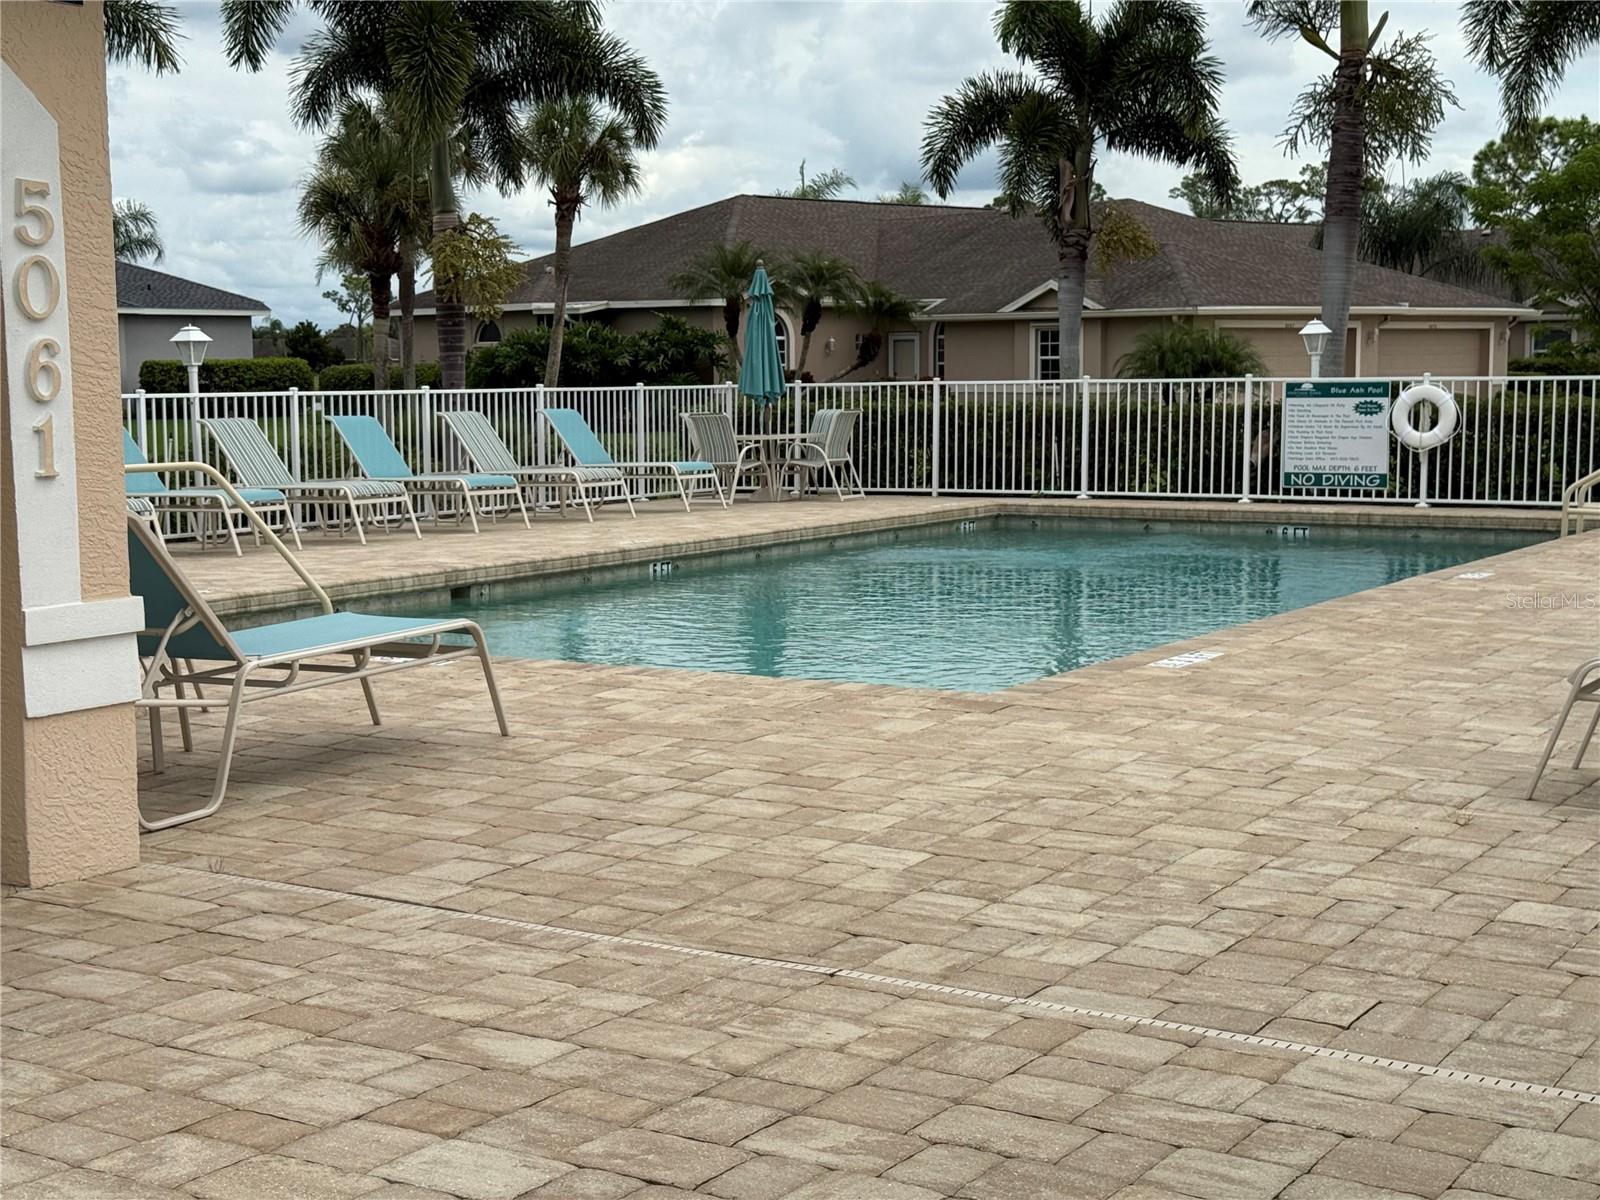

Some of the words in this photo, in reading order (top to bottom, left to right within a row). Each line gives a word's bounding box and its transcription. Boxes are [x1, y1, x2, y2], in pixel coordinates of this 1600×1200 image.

[14, 177, 61, 480] 5061
[1330, 386, 1347, 394] Blue
[1350, 386, 1365, 394] Ash
[1367, 386, 1384, 394] Pool
[1290, 473, 1315, 486] NO
[1322, 474, 1381, 487] DIVING
